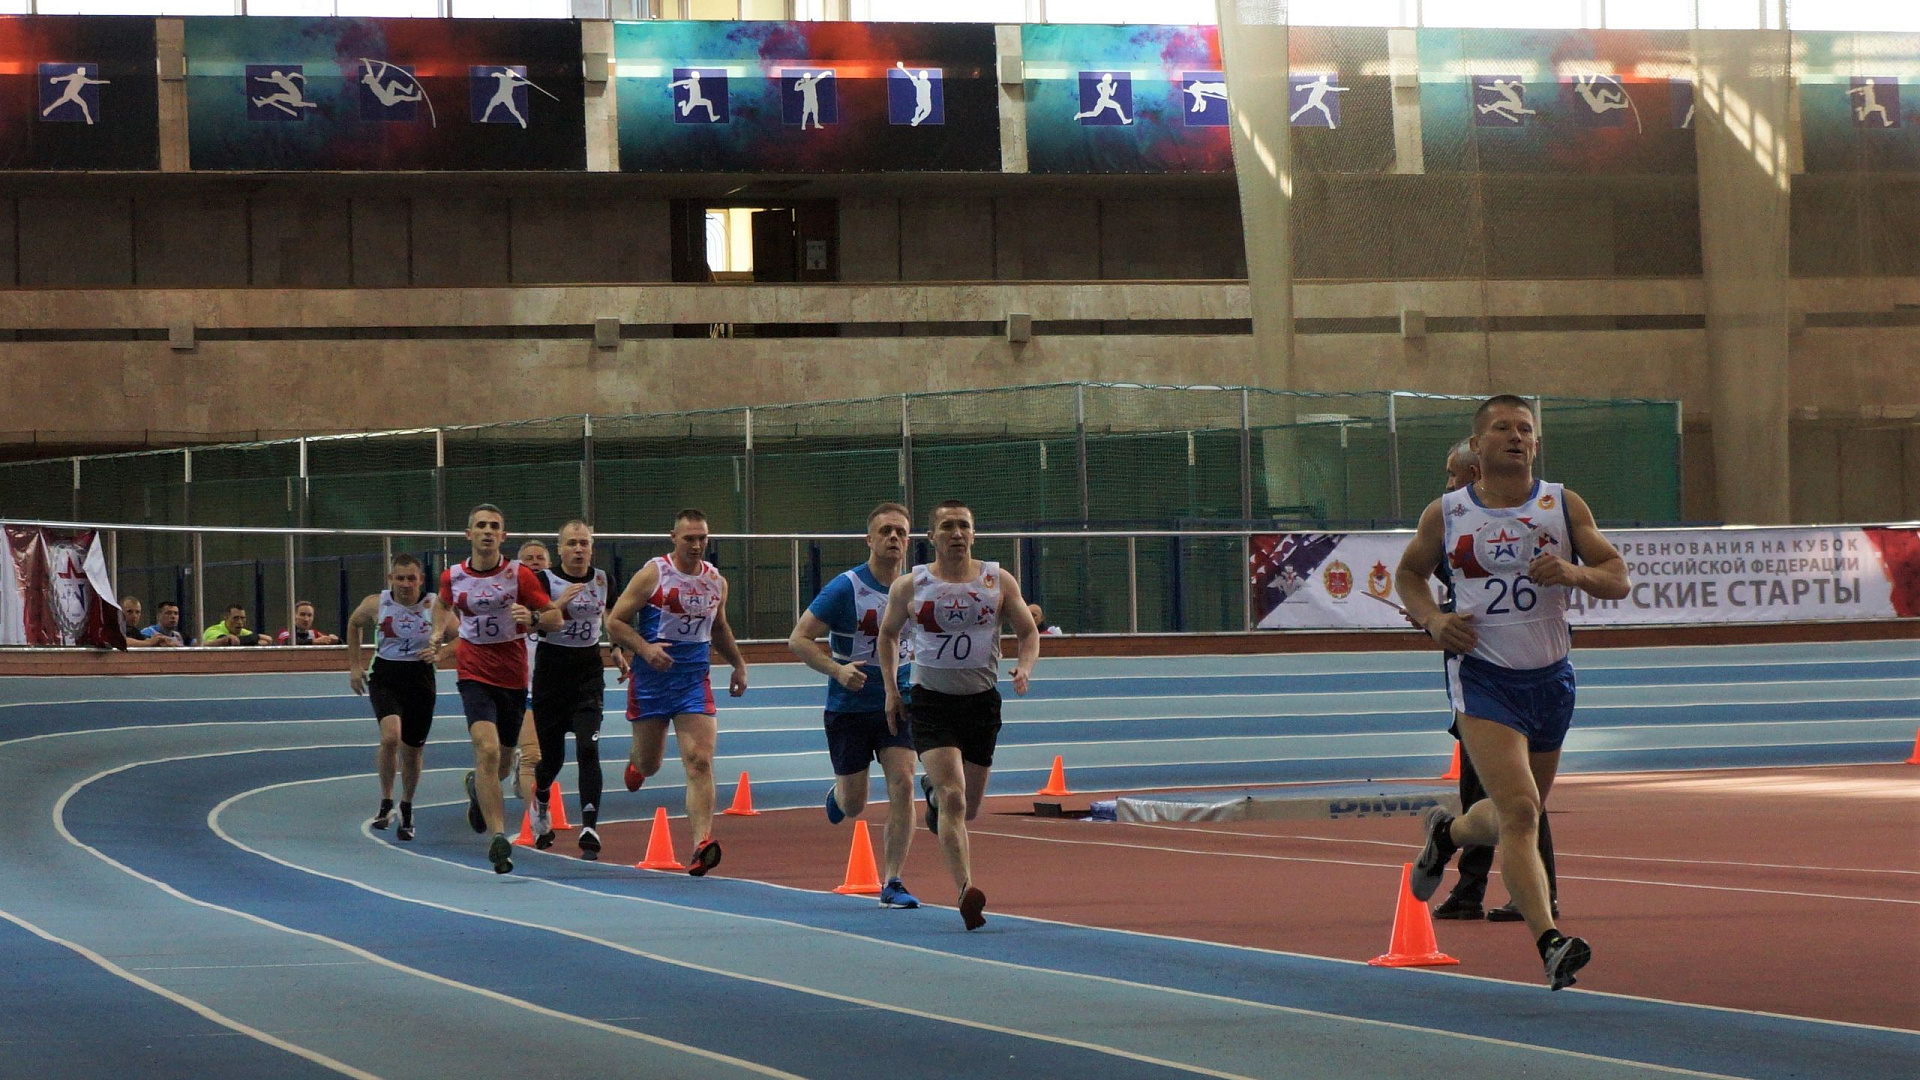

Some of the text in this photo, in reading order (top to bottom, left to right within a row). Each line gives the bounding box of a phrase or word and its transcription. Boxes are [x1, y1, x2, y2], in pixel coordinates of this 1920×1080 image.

[1762, 540, 1786, 553] НА
[1793, 538, 1858, 551] КУБОК
[1627, 557, 1860, 576] РОССИЙСКОЙ ФЕДЕРАЦИИ
[1484, 575, 1537, 615] 26
[1727, 577, 1861, 607] СТАРТЫ
[474, 616, 499, 637] 15
[564, 621, 592, 641] 48
[677, 614, 707, 635] 37
[936, 634, 972, 660] 70
